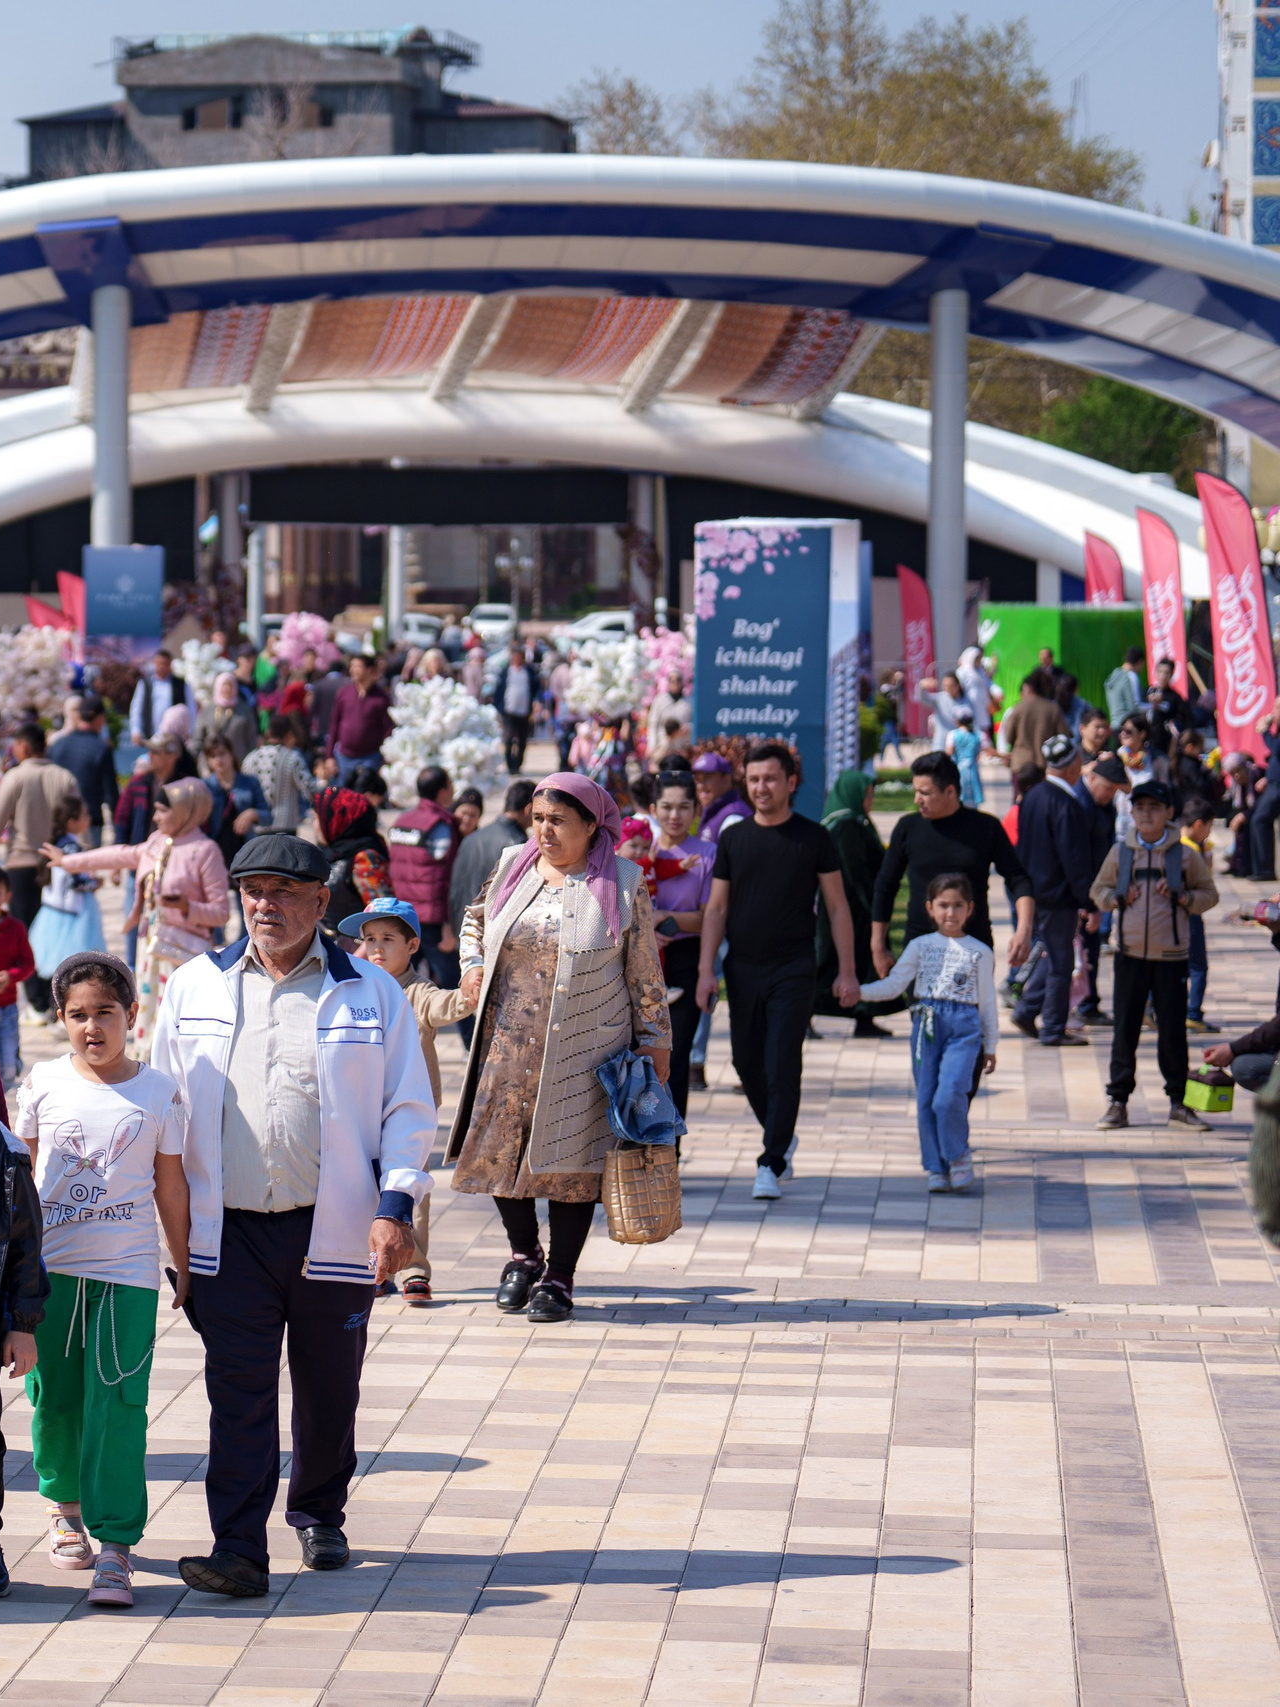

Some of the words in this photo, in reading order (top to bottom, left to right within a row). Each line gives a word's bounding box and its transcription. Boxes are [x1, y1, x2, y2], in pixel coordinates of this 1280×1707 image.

[714, 646, 804, 671] ichidagi
[718, 675, 798, 695] shahar
[715, 703, 800, 728] qanday
[350, 1007, 377, 1017] BOSS
[70, 1183, 107, 1204] or
[42, 1200, 134, 1225] TREAT
